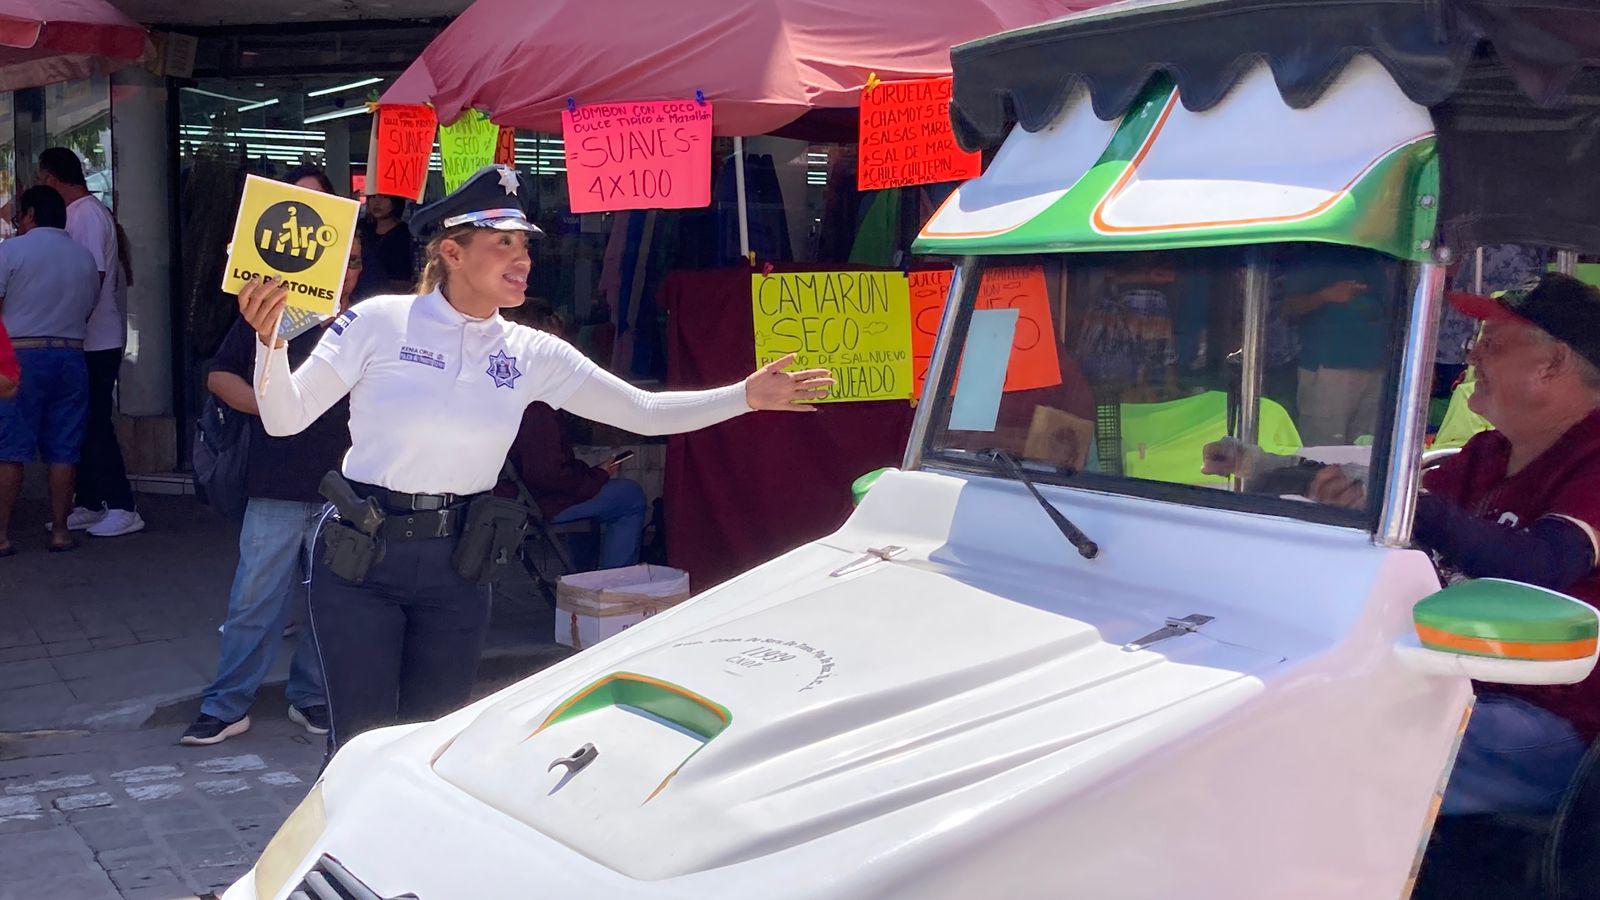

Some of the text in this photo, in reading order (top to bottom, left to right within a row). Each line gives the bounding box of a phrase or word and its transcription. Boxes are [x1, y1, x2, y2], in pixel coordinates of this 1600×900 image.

[571, 102, 695, 124] BOMBON CON COCO
[870, 105, 922, 129] CHAMOY
[573, 119, 612, 134] DULCE
[868, 126, 918, 147] SALSAS
[453, 136, 480, 156] SECO
[868, 147, 900, 168] SAL
[904, 144, 919, 161] DE
[868, 164, 899, 183] CHILE
[263, 275, 335, 301] PATONES
[908, 272, 943, 288] DULCE
[758, 272, 889, 317] CAMARON
[767, 317, 860, 355] SECO
[401, 345, 418, 354] KENIA
[818, 353, 836, 365] DE
[839, 353, 869, 366] SAL
[869, 350, 907, 364] NUEVO
